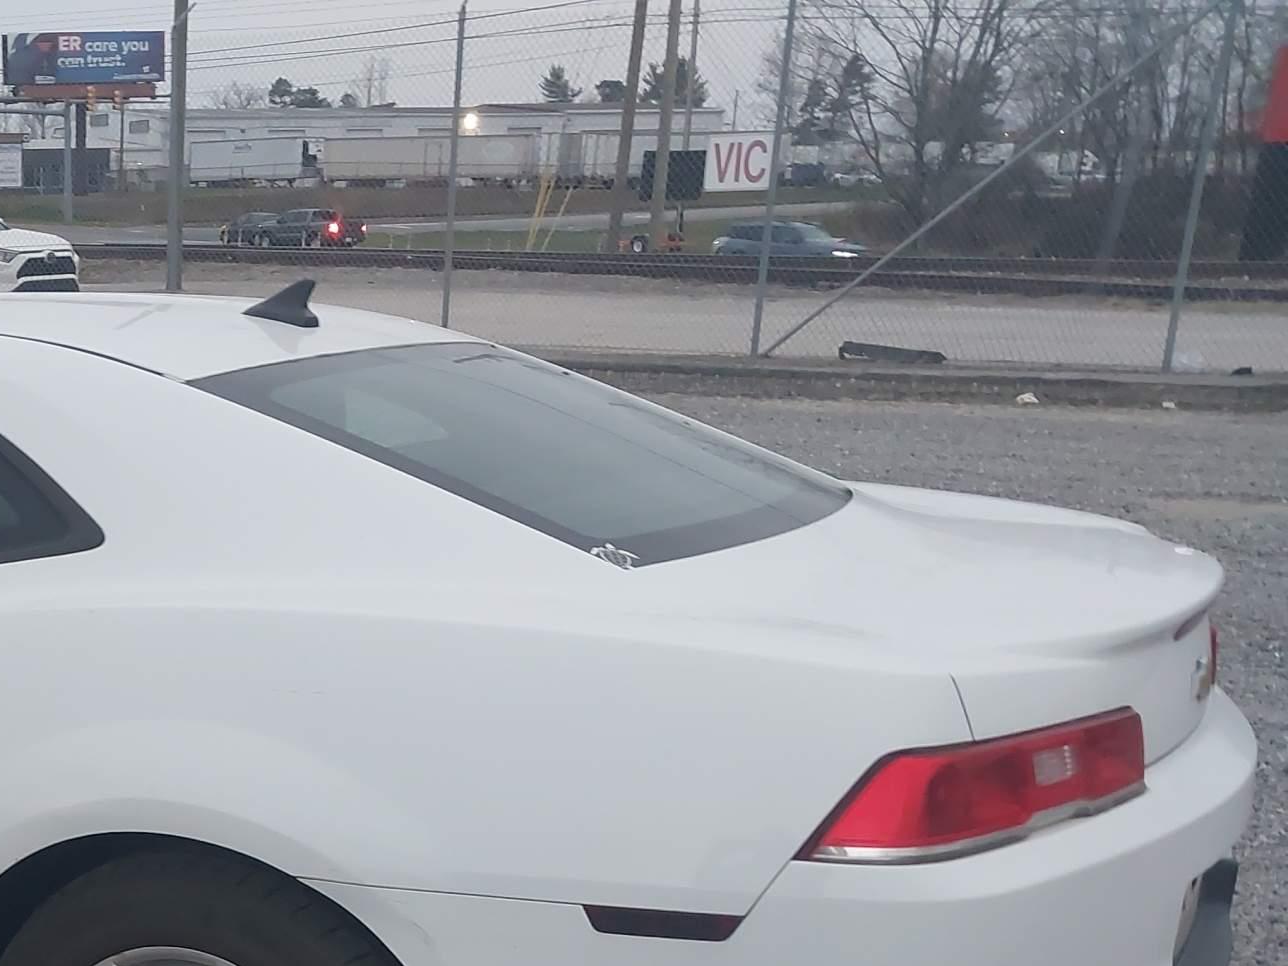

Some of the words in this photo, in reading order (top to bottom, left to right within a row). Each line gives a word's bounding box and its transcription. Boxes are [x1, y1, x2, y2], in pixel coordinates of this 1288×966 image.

[58, 36, 82, 52] ER
[85, 41, 118, 52] care
[121, 40, 149, 54] you
[57, 57, 84, 67] can
[86, 55, 126, 67] trust.
[714, 139, 767, 183] VIC
